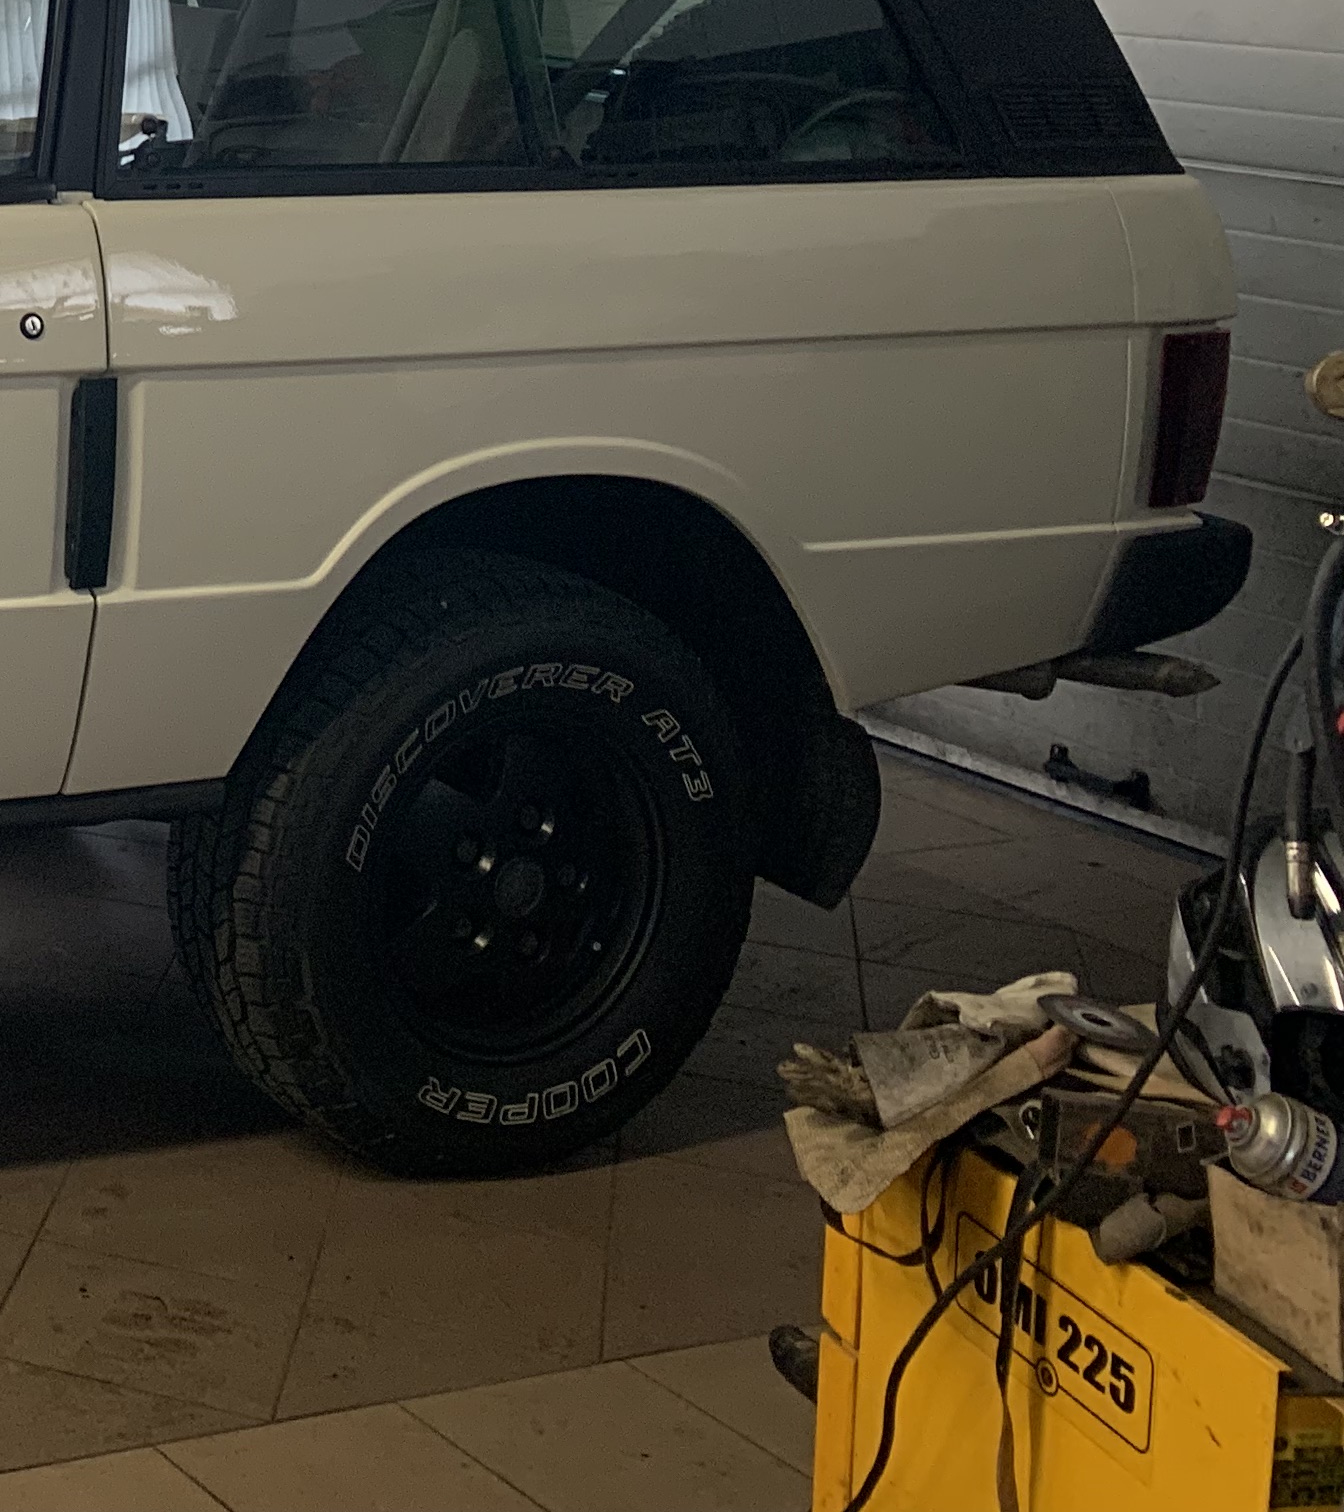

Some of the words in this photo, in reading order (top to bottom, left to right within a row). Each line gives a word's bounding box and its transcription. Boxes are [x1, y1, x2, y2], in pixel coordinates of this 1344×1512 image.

[346, 662, 635, 872] DISCOVERER
[642, 708, 714, 803] AT3
[418, 1028, 653, 1125] COOPER
[1056, 1313, 1136, 1416] 225
